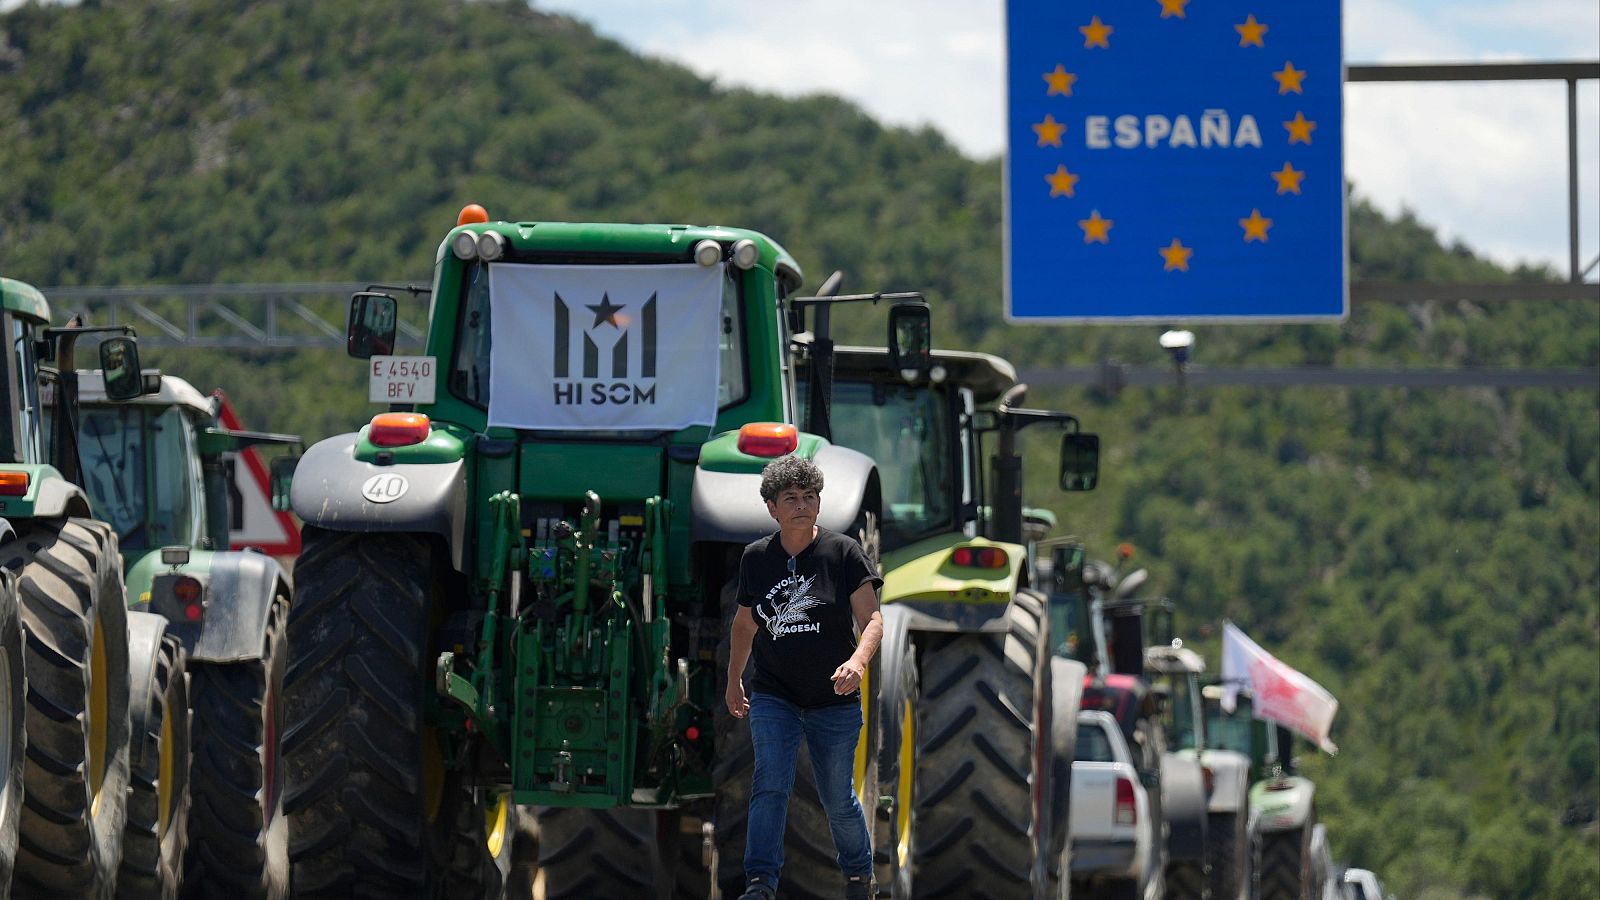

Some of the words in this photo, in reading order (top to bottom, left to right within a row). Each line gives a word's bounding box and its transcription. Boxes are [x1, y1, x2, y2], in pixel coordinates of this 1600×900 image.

[1085, 108, 1264, 149] ESPAÑA
[373, 361, 382, 376] E
[388, 361, 430, 377] 4540
[387, 382, 415, 398] BFV
[554, 383, 582, 405] HI
[590, 382, 656, 405] SOM
[368, 477, 403, 497] 40
